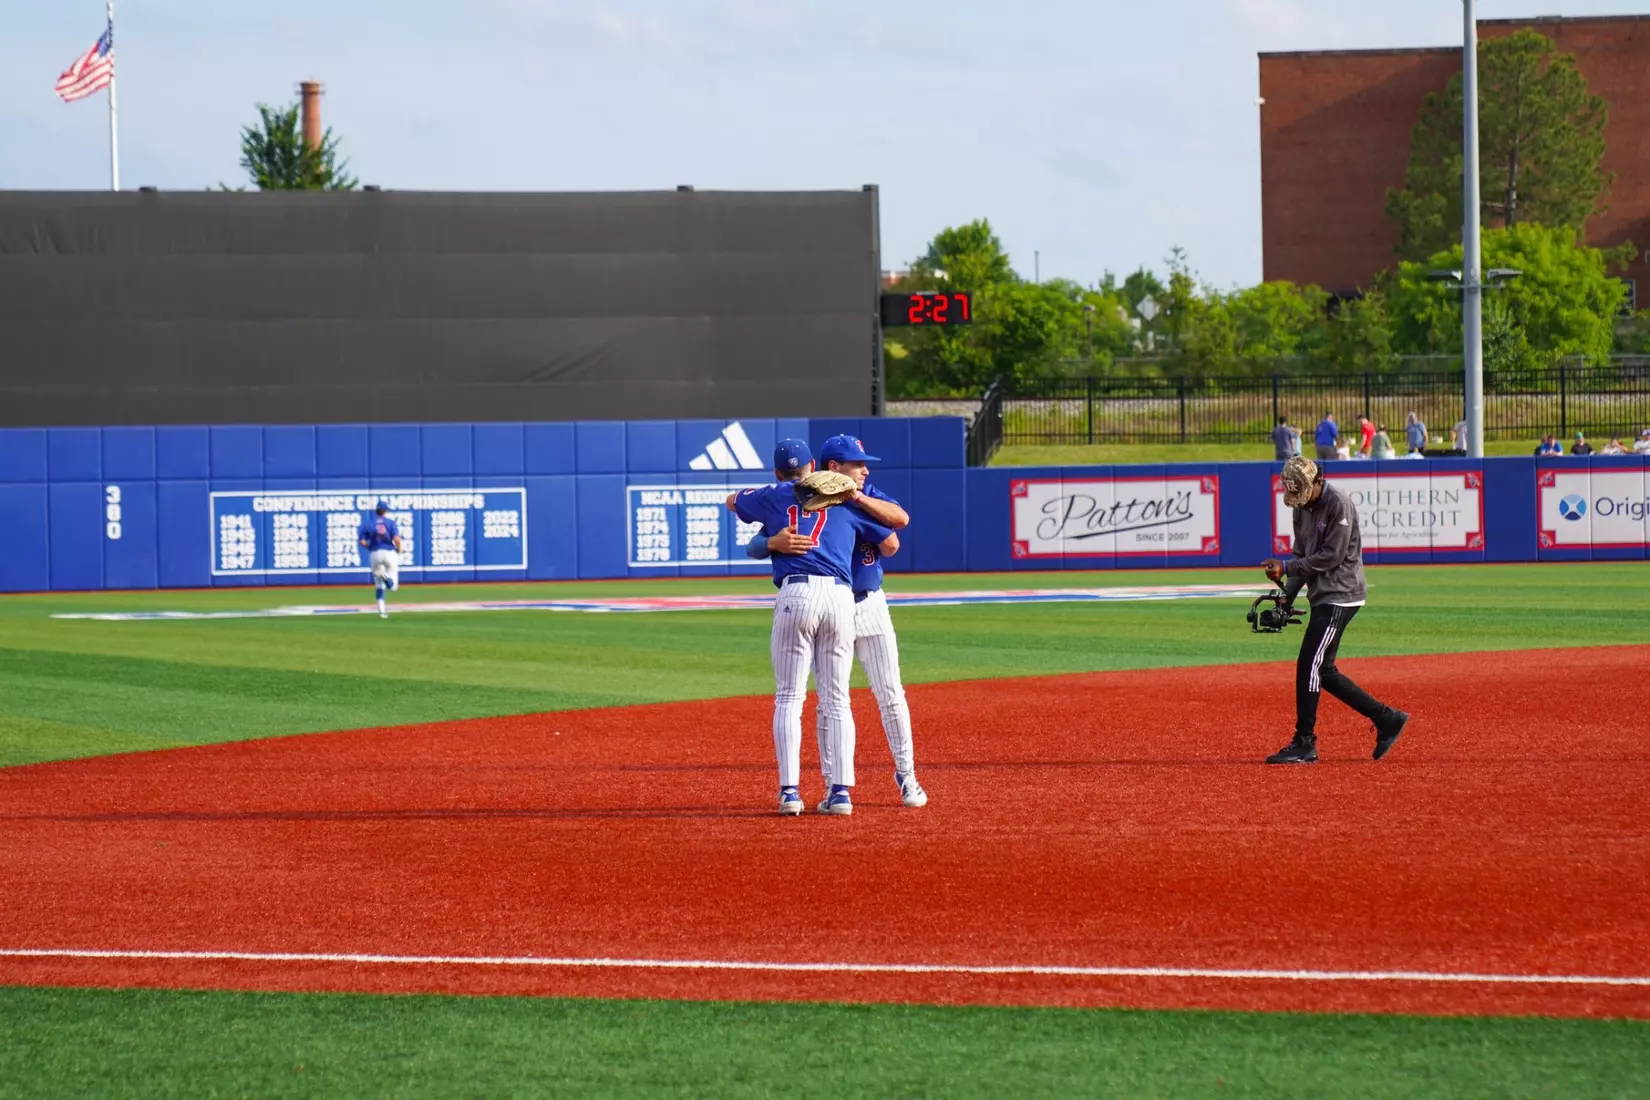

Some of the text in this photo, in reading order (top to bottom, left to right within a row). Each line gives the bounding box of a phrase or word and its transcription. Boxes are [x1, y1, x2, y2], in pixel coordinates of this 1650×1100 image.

[908, 293, 969, 323] 2:27
[253, 496, 355, 511] CONFERENCE
[641, 491, 683, 505] NCAA
[1349, 488, 1460, 506] OUTHERN
[637, 507, 665, 520] 1971
[1036, 491, 1192, 541] Patton's
[1359, 508, 1461, 528] GCREDIT
[221, 516, 251, 528] 1941
[786, 505, 827, 548] 17
[1135, 532, 1190, 542] SINCE 2007
